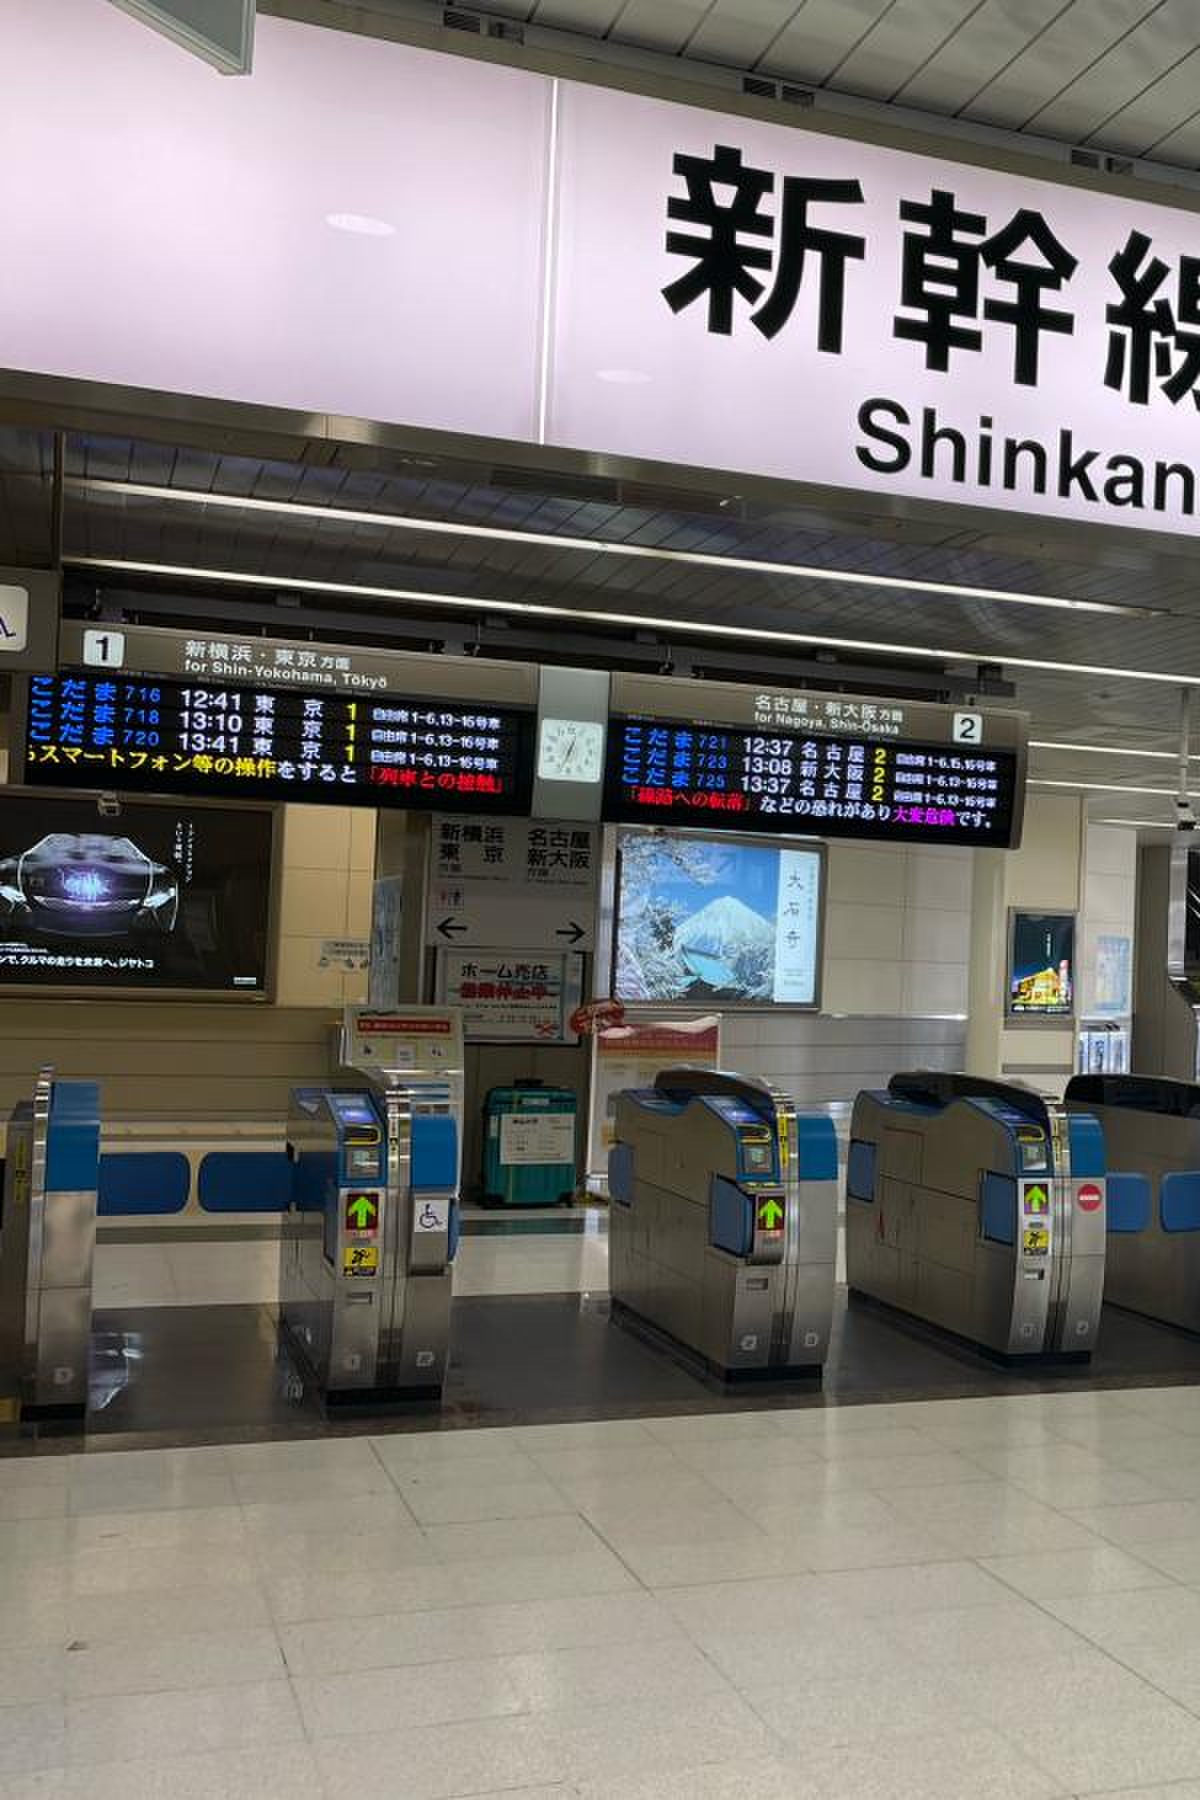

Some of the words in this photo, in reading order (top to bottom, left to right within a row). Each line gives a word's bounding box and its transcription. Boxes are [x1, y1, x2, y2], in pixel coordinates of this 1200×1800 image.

[95, 635, 109, 661] 1
[185, 659, 209, 672] for
[31, 677, 116, 702] こだま
[125, 685, 161, 702] 716
[180, 689, 242, 711] 12:41
[31, 700, 116, 724] こだま
[124, 708, 160, 725] 718
[179, 711, 243, 733] 13:10
[959, 718, 976, 739] 2
[30, 721, 115, 746] こだま
[123, 730, 160, 747] 720
[178, 733, 240, 754] 13:41
[743, 737, 793, 756] 12:37
[874, 748, 886, 765] 2
[742, 756, 793, 775] 13:08
[873, 768, 885, 783] 2
[740, 776, 791, 795] 13:37
[872, 786, 884, 801] 2
[528, 828, 591, 849] 名古屋
[528, 849, 591, 870] 新大阪
